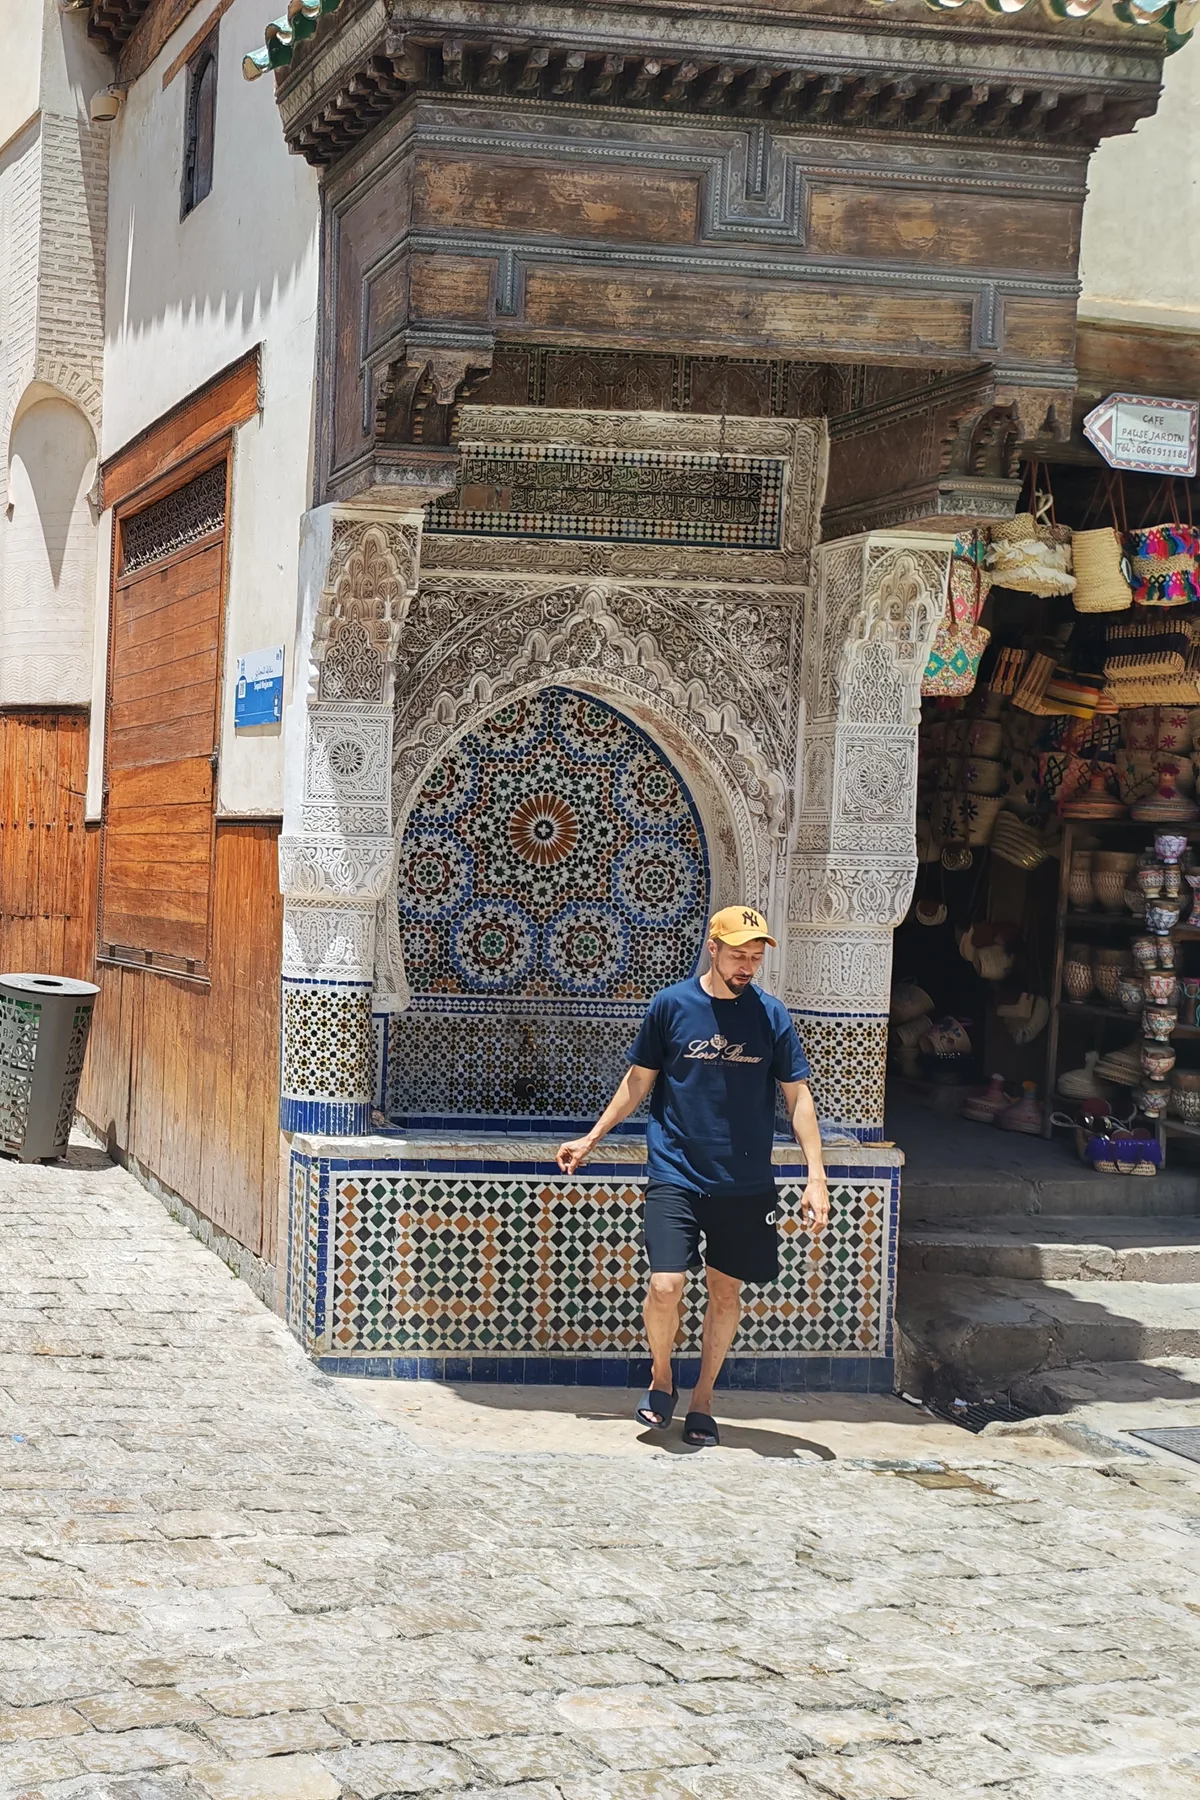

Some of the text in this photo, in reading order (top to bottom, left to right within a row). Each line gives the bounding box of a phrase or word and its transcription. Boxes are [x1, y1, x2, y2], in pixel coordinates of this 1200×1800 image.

[1142, 415, 1165, 426] CAFE
[1122, 428, 1185, 443] PAUSE JARDIN
[1136, 445, 1188, 460] 0661911188
[742, 911, 760, 928] NY
[683, 1039, 764, 1064] Loro Piana
